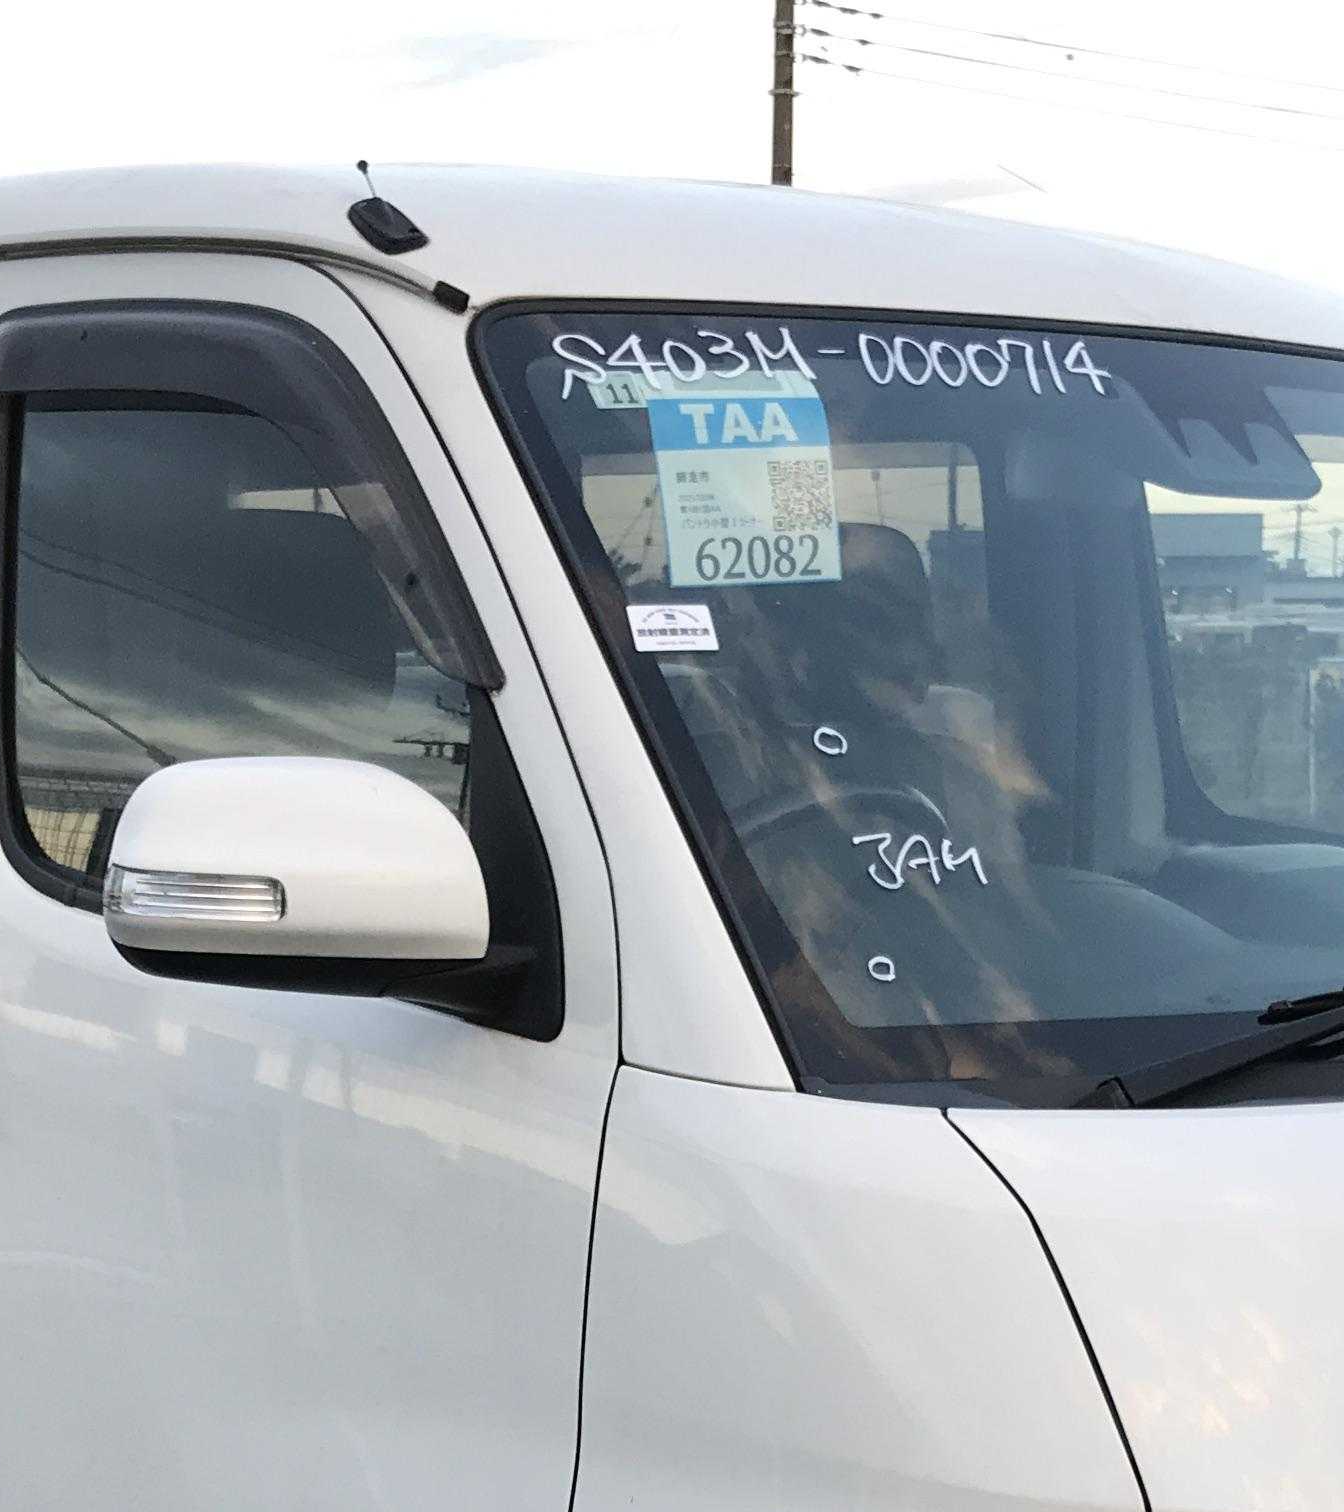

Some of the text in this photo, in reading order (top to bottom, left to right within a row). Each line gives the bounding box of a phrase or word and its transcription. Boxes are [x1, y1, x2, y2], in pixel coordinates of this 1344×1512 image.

[606, 383, 639, 404] 11
[678, 402, 799, 444] TAA
[695, 534, 822, 581] 62082
